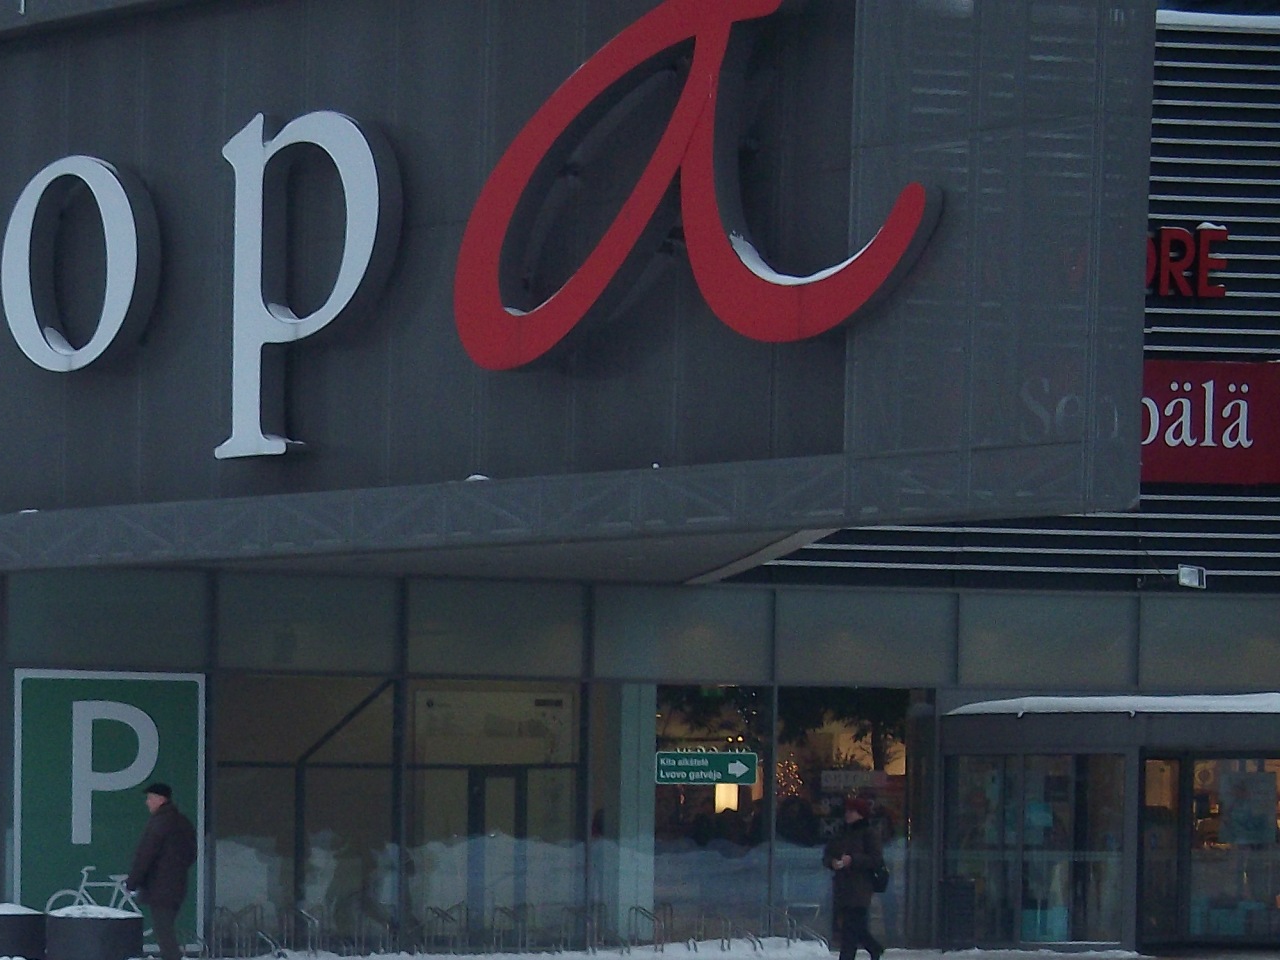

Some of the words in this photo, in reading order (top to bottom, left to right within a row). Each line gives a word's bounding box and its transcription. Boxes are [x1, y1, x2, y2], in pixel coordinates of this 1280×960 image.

[660, 757, 676, 766] Kita
[72, 700, 159, 844] P
[660, 769, 687, 779] Lvovo
